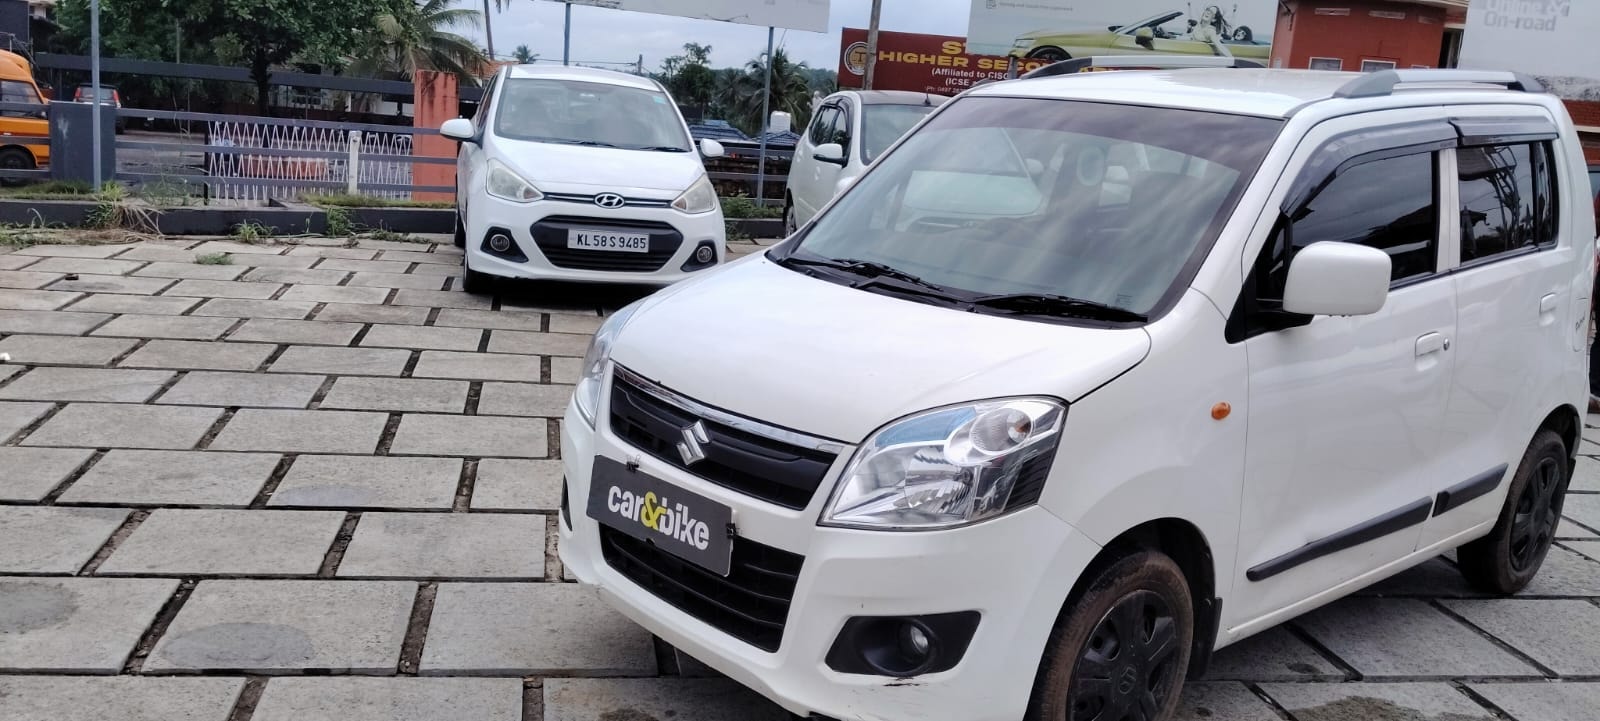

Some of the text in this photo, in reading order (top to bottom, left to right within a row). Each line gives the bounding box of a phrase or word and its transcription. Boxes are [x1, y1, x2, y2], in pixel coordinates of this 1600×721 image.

[1484, 11, 1557, 32] On-road
[942, 41, 966, 55] S
[878, 51, 968, 68] HIGHER
[931, 68, 974, 78] (Affiliated
[577, 234, 646, 249] KL 58 S 9485
[607, 485, 710, 551] car&bike
